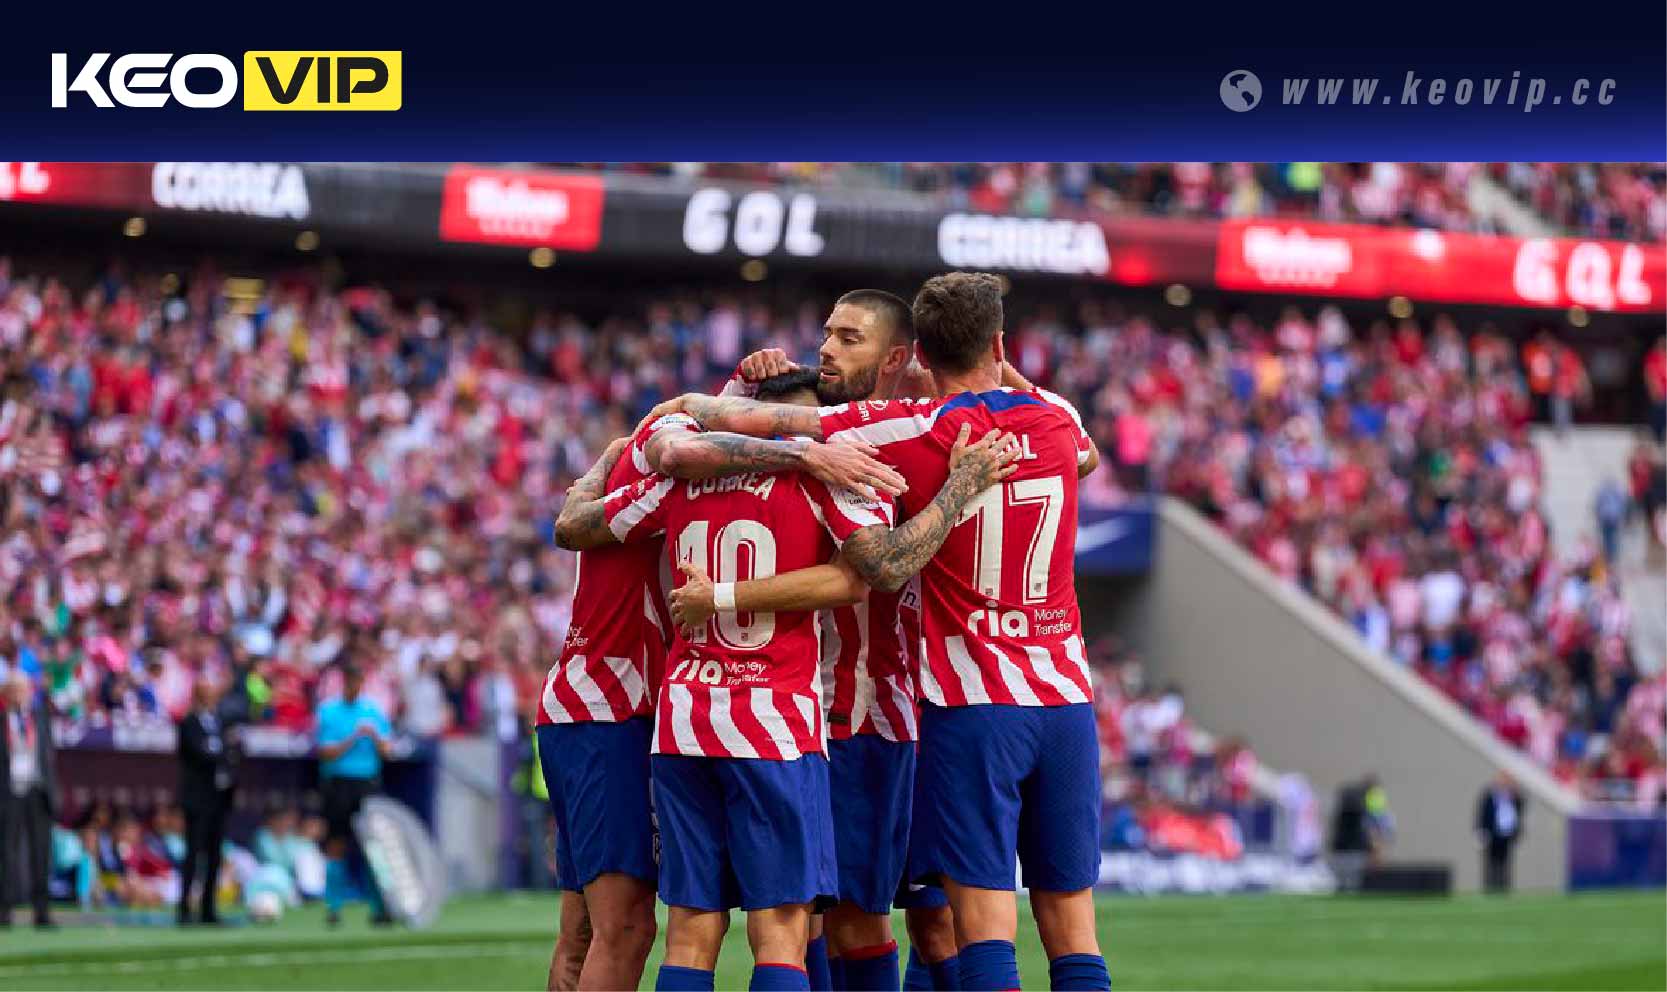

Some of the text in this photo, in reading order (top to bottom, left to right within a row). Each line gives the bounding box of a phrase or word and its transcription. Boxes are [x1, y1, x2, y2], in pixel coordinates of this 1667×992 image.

[684, 188, 824, 257] GOL
[675, 519, 777, 651] 10
[954, 475, 1064, 605] 17
[967, 600, 1029, 638] ria
